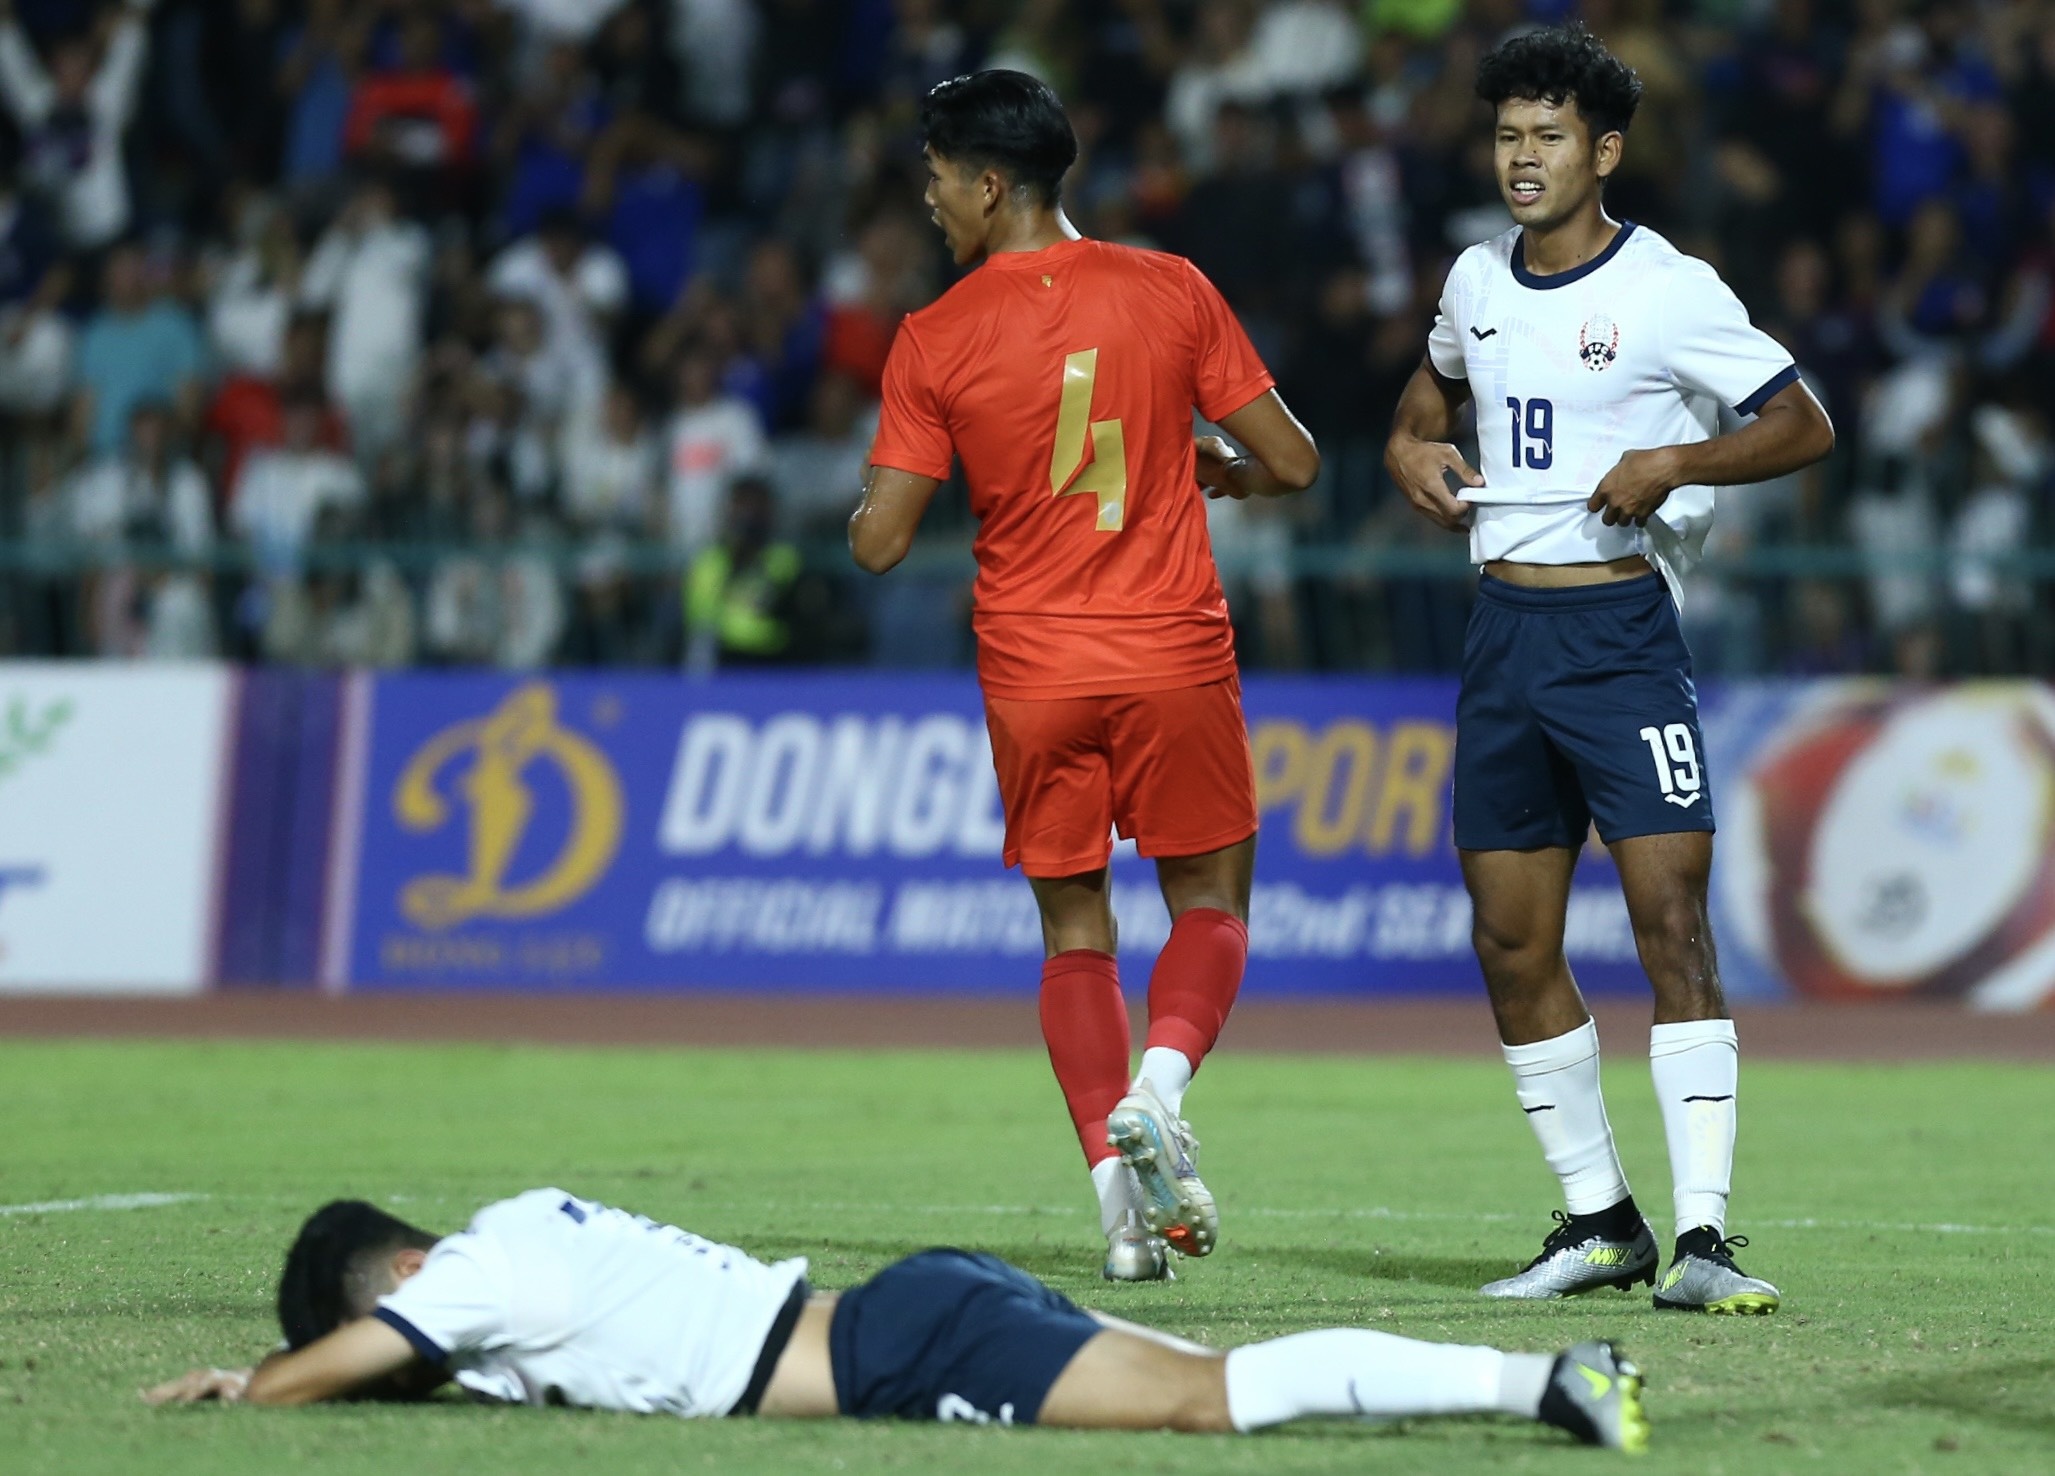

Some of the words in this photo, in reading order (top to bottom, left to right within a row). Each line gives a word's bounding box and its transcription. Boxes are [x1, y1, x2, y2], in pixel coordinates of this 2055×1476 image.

[1588, 344, 1610, 355] FFC
[1050, 347, 1127, 531] 4
[1506, 396, 1553, 470] 19
[659, 713, 1004, 856] DONGL
[1252, 718, 1453, 859] POR
[1639, 723, 1701, 794] 19
[646, 878, 882, 954] OFFICIAL
[890, 880, 1044, 956] MATC
